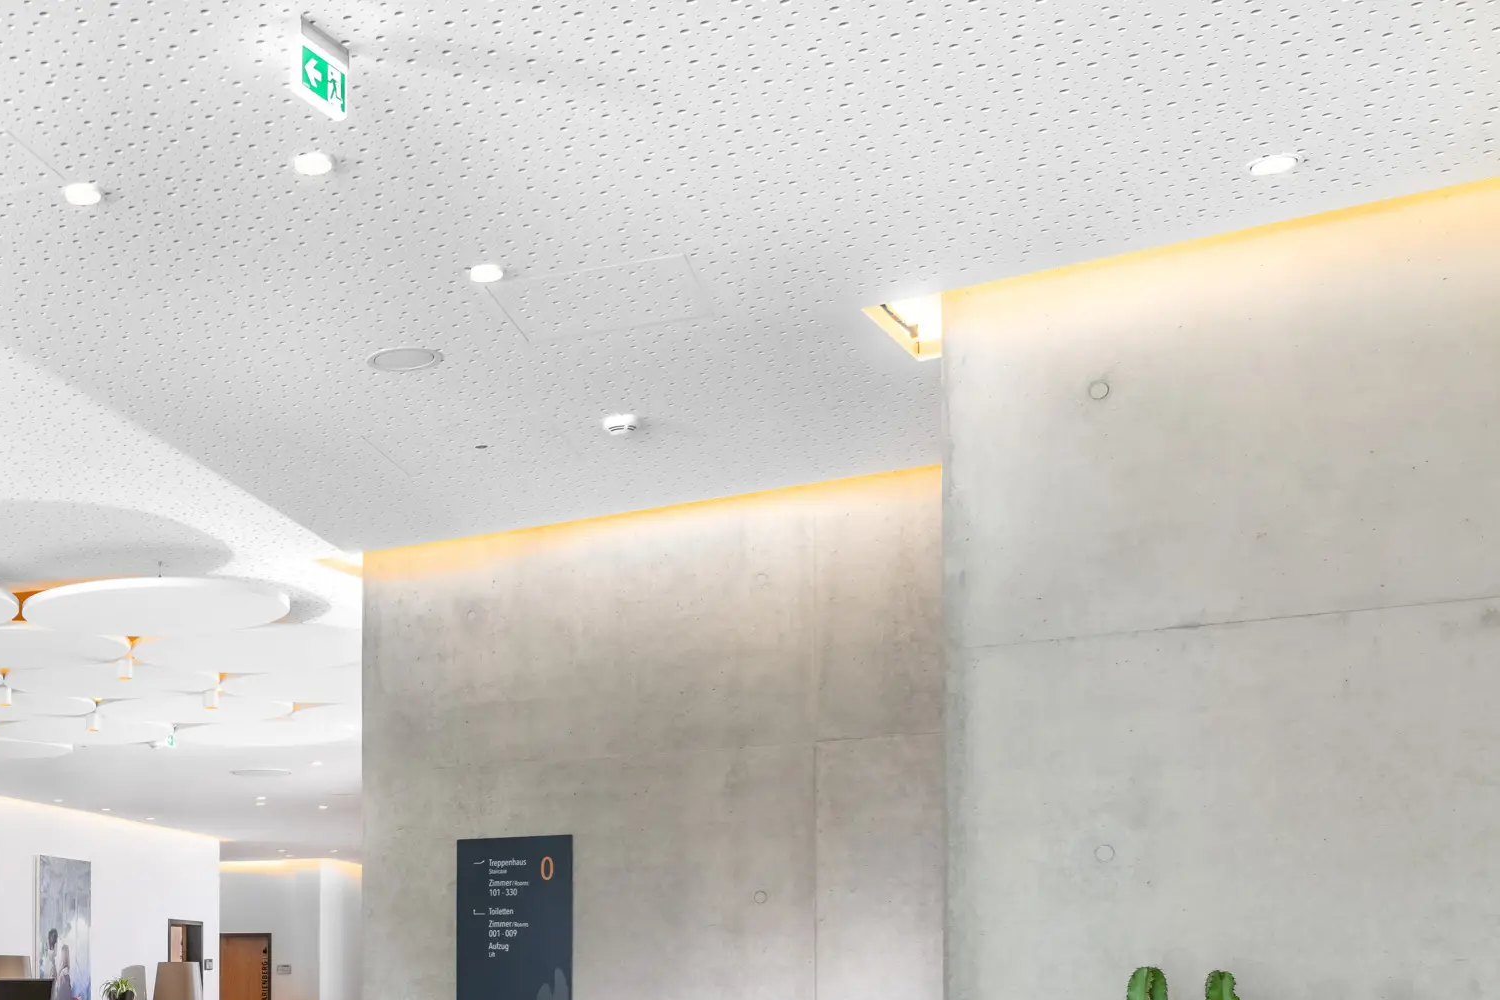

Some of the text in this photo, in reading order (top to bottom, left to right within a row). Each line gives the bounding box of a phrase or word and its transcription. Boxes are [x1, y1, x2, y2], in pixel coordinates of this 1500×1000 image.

[489, 858, 527, 868] Treppenhaus
[540, 856, 554, 881] 0
[505, 888, 518, 896] 330
[489, 907, 514, 915] Toiletten
[489, 929, 501, 937] 001
[505, 929, 518, 937] 009
[489, 942, 509, 951] Aufzug
